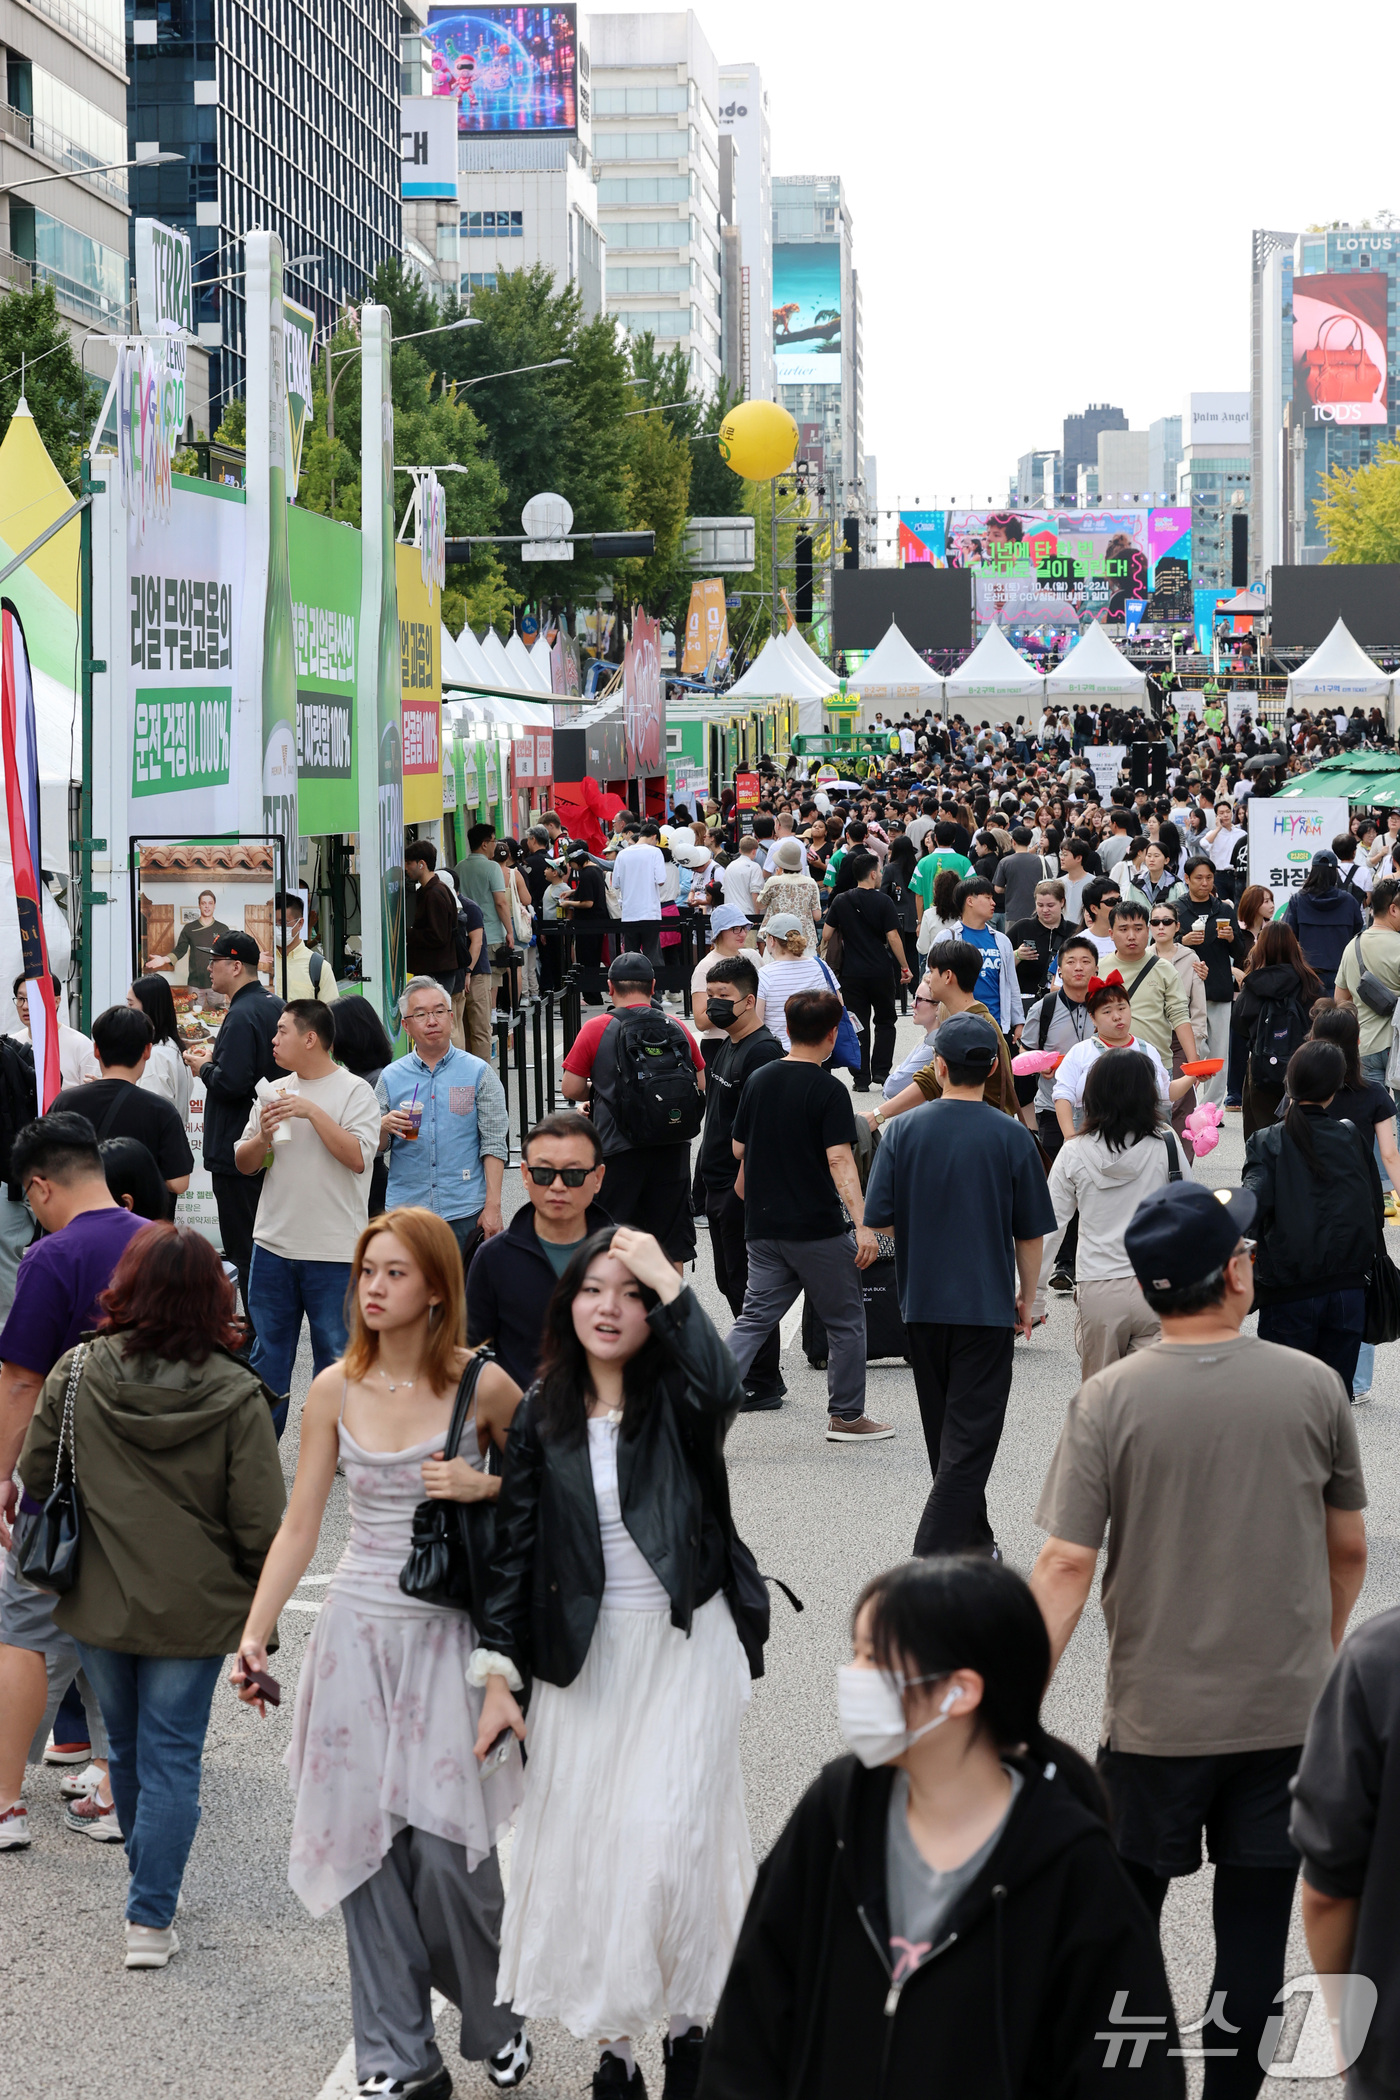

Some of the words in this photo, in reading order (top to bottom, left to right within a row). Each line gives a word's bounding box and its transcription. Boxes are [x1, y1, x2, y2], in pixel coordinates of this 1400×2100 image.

[1336, 238, 1392, 250] LOTUS
[152, 227, 192, 331] TERRA
[1193, 412, 1219, 423] Palm
[1311, 403, 1362, 421] TOD'S
[988, 541, 1030, 559] 1년에
[1034, 541, 1049, 559] 단
[1056, 541, 1072, 559] 한
[965, 560, 1030, 578] 도산대로
[1035, 560, 1068, 578] 길이
[1073, 560, 1128, 578] 열린다!
[983, 592, 1017, 601] 도산대로
[1092, 592, 1109, 601] 일대
[131, 574, 161, 670] 리얼
[164, 577, 232, 671] 무알코올의
[136, 703, 161, 782] 운전
[163, 702, 187, 779] 걱정
[188, 700, 229, 775] 0.000%
[330, 706, 351, 768] 100%
[422, 711, 438, 764] 100%
[1299, 816, 1324, 828] GANG
[1299, 825, 1322, 836] NAM
[1269, 867, 1311, 888] 화장
[174, 1203, 201, 1213] 토랑은
